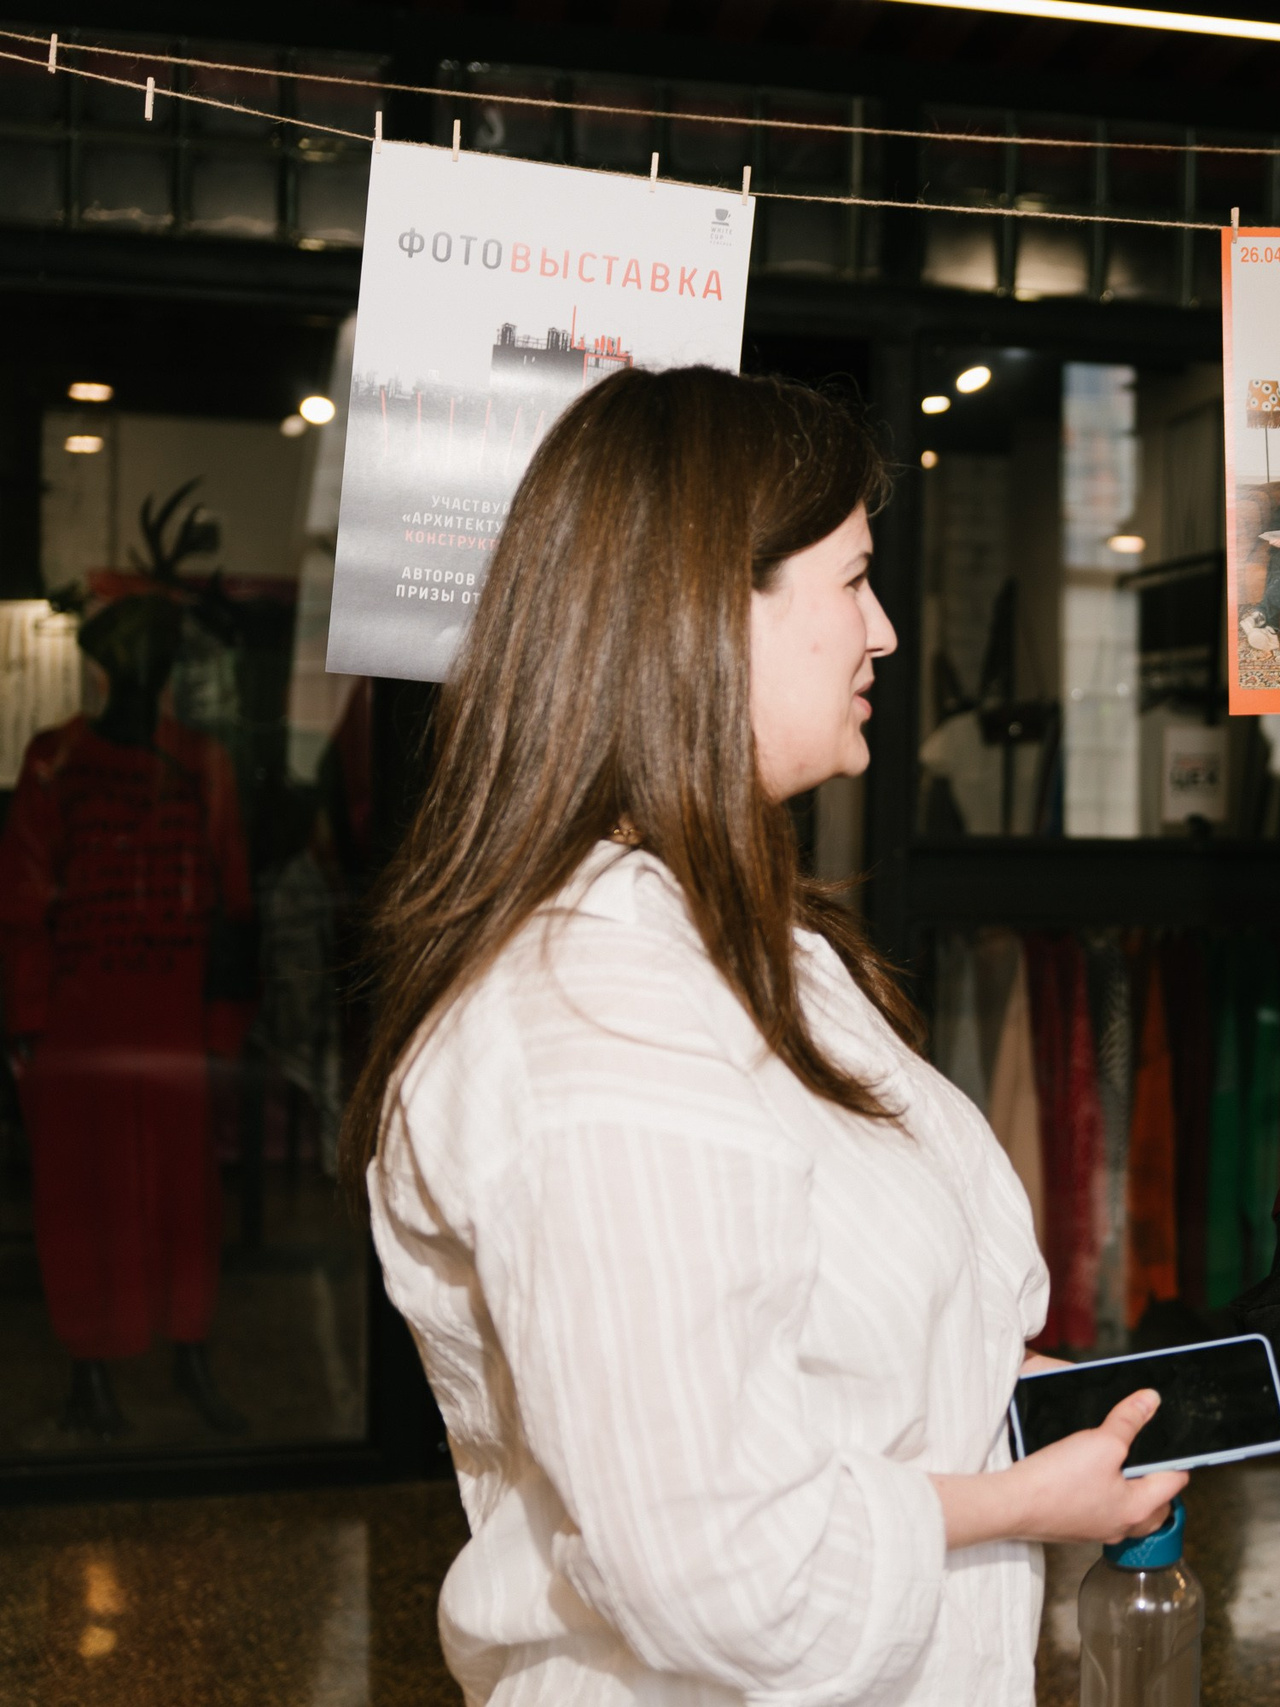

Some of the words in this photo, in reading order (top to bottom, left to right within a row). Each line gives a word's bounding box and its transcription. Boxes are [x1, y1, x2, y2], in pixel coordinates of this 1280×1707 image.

[398, 228, 722, 301] ФОТОВЫСТАВКА
[401, 566, 476, 586] АВТОРОВ
[396, 584, 455, 602] ПРИЗЫ
